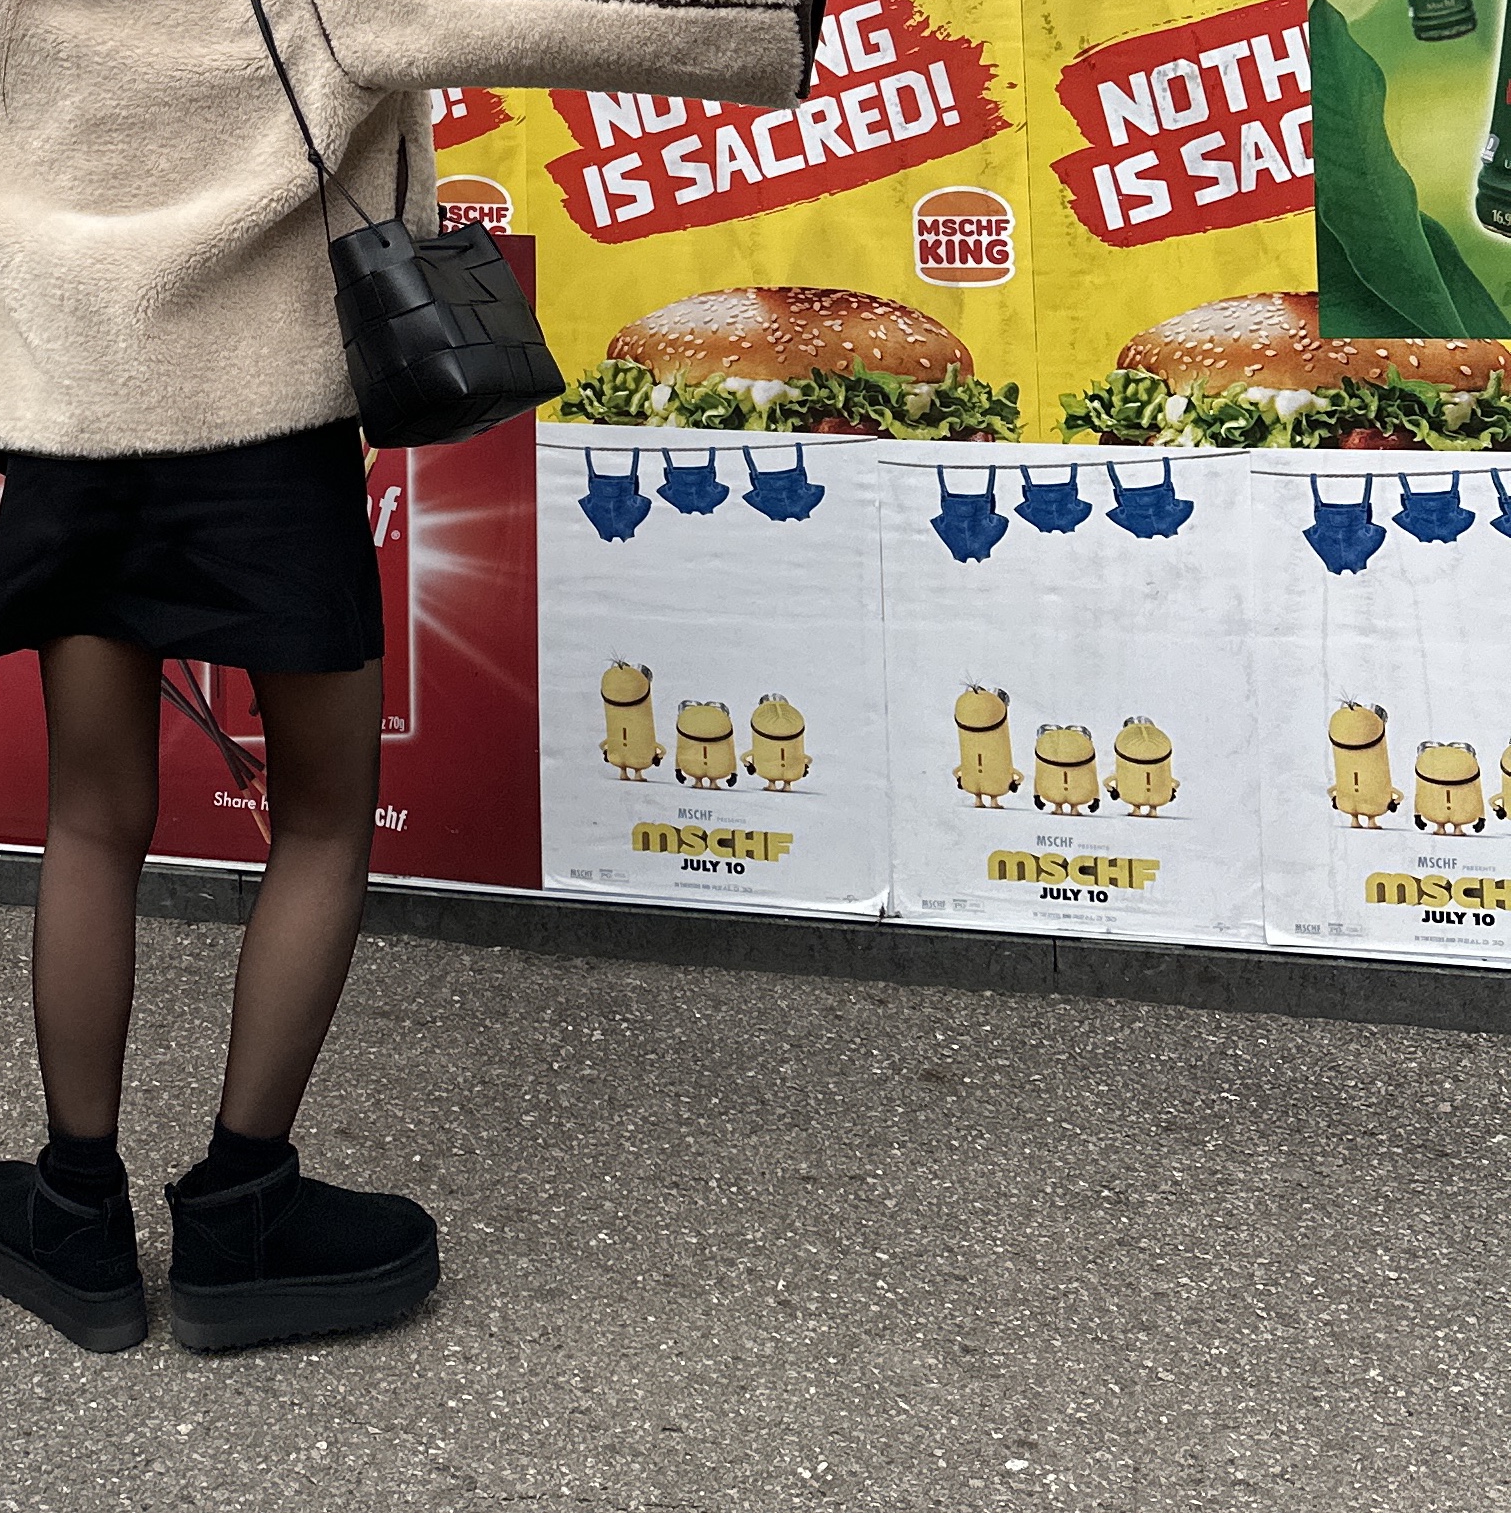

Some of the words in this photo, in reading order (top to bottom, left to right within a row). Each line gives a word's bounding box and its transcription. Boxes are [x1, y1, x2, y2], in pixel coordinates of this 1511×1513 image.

[583, 152, 655, 228] IS
[661, 61, 961, 206] SACRED!
[1092, 150, 1173, 231] IS
[444, 205, 510, 223] SCHF
[918, 218, 1009, 238] MSCHF
[918, 238, 1009, 265] KING
[213, 791, 256, 810] Share
[677, 808, 713, 821] MSCHF
[1036, 835, 1074, 848] MSCHF
[681, 858, 721, 873] JULY
[726, 861, 746, 875] 10
[1417, 856, 1458, 870] MSCHF
[1040, 887, 1083, 902] JULY
[1087, 890, 1109, 903] 10
[1365, 871, 1511, 910] MSCH
[1421, 910, 1468, 925] JULY
[1473, 913, 1496, 926] 10
